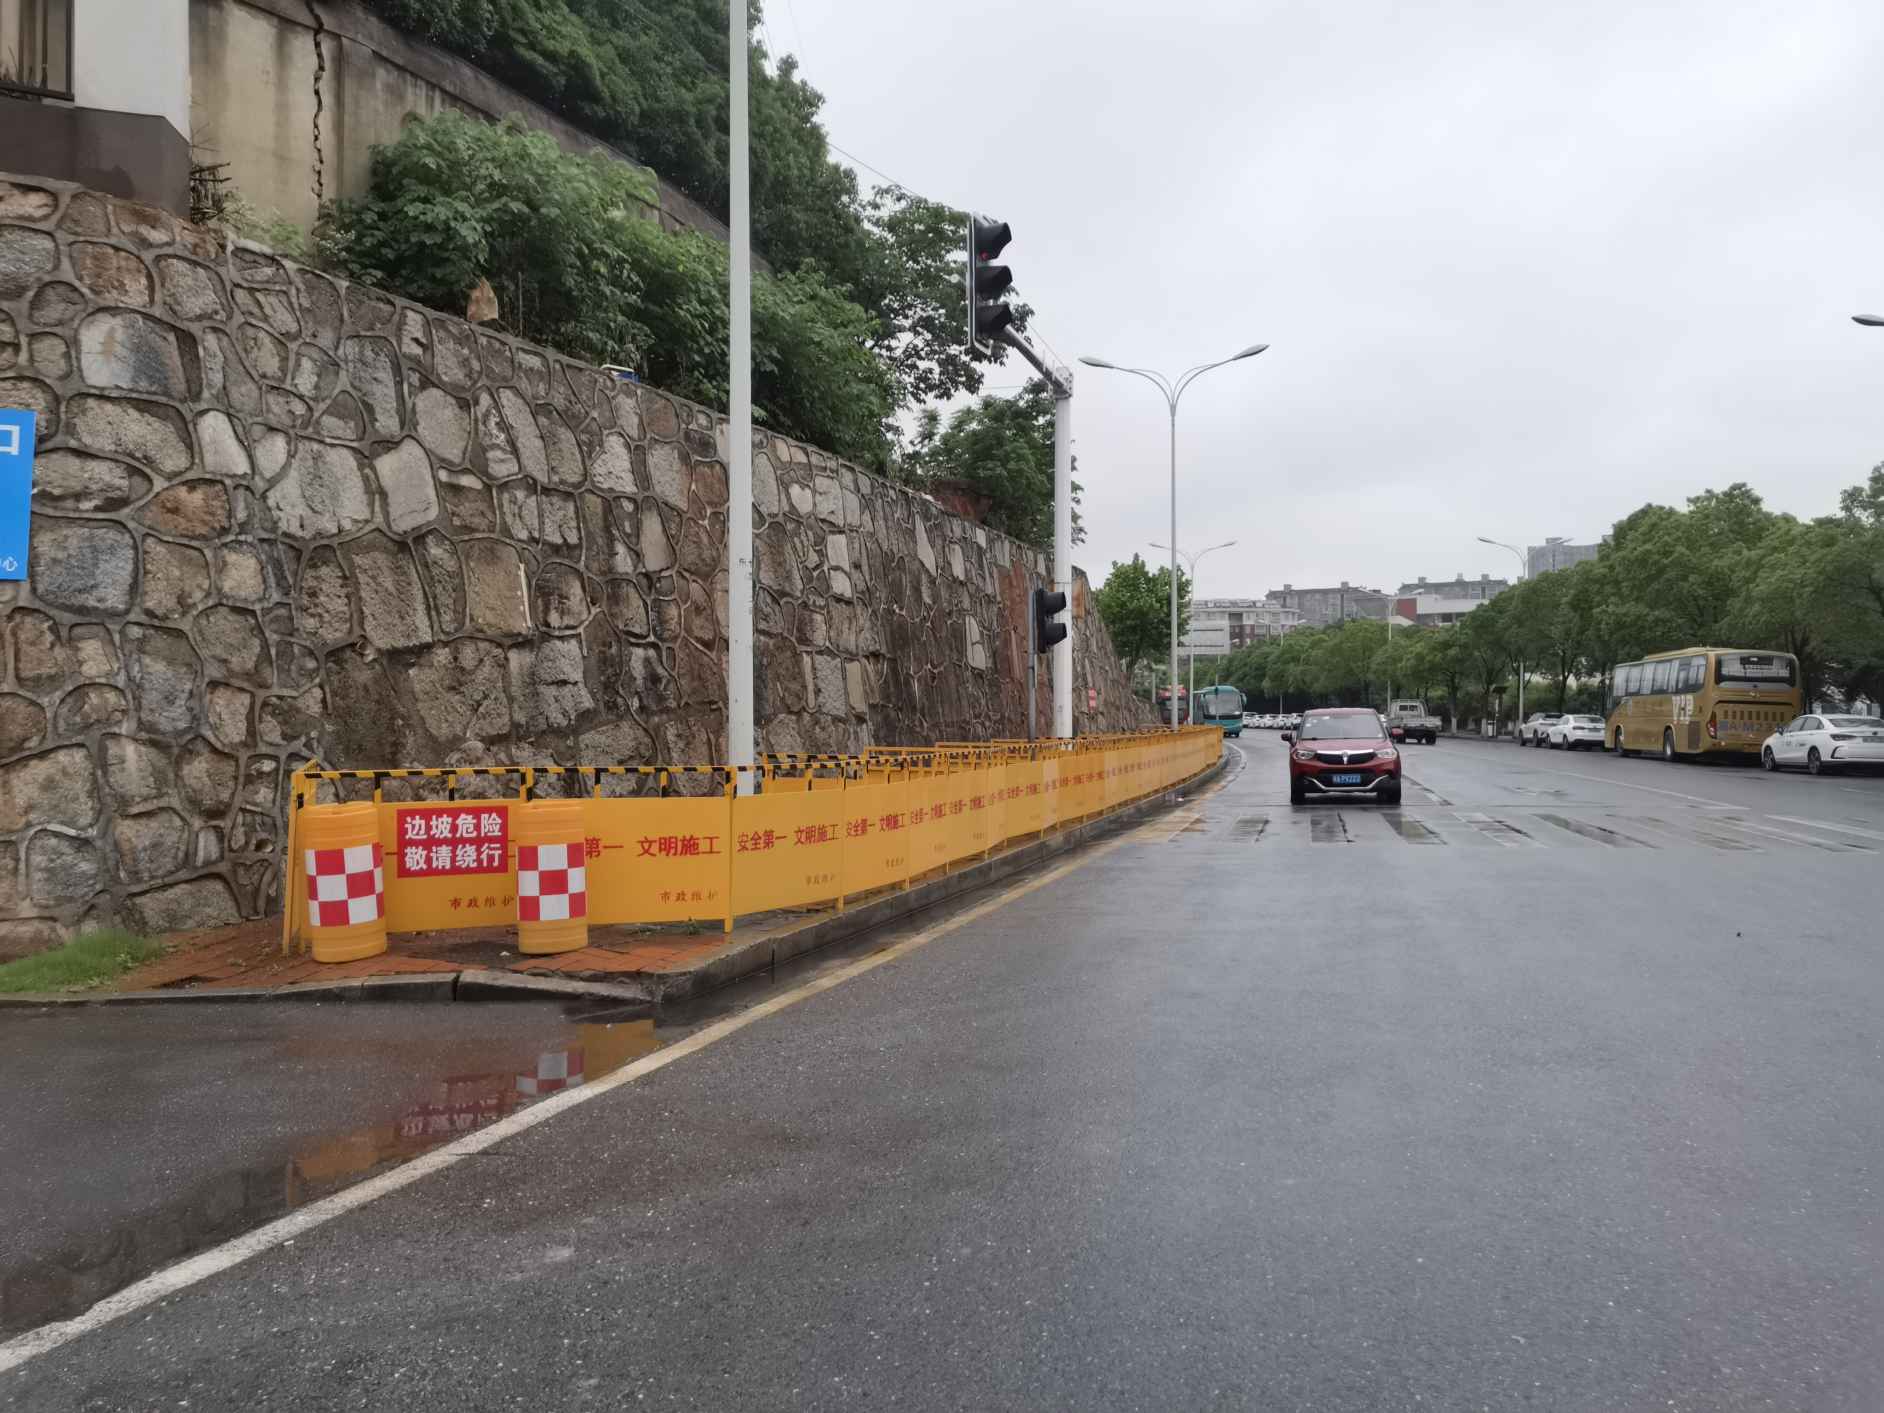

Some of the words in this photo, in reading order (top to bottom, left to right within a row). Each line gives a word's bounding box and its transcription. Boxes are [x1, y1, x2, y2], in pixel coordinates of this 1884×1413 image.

[404, 812, 502, 840] 边坡危险
[737, 829, 787, 853] 安全第一
[794, 823, 840, 846] 文明施工
[404, 842, 502, 871] 敬请绕行
[636, 834, 722, 857] 文明施工
